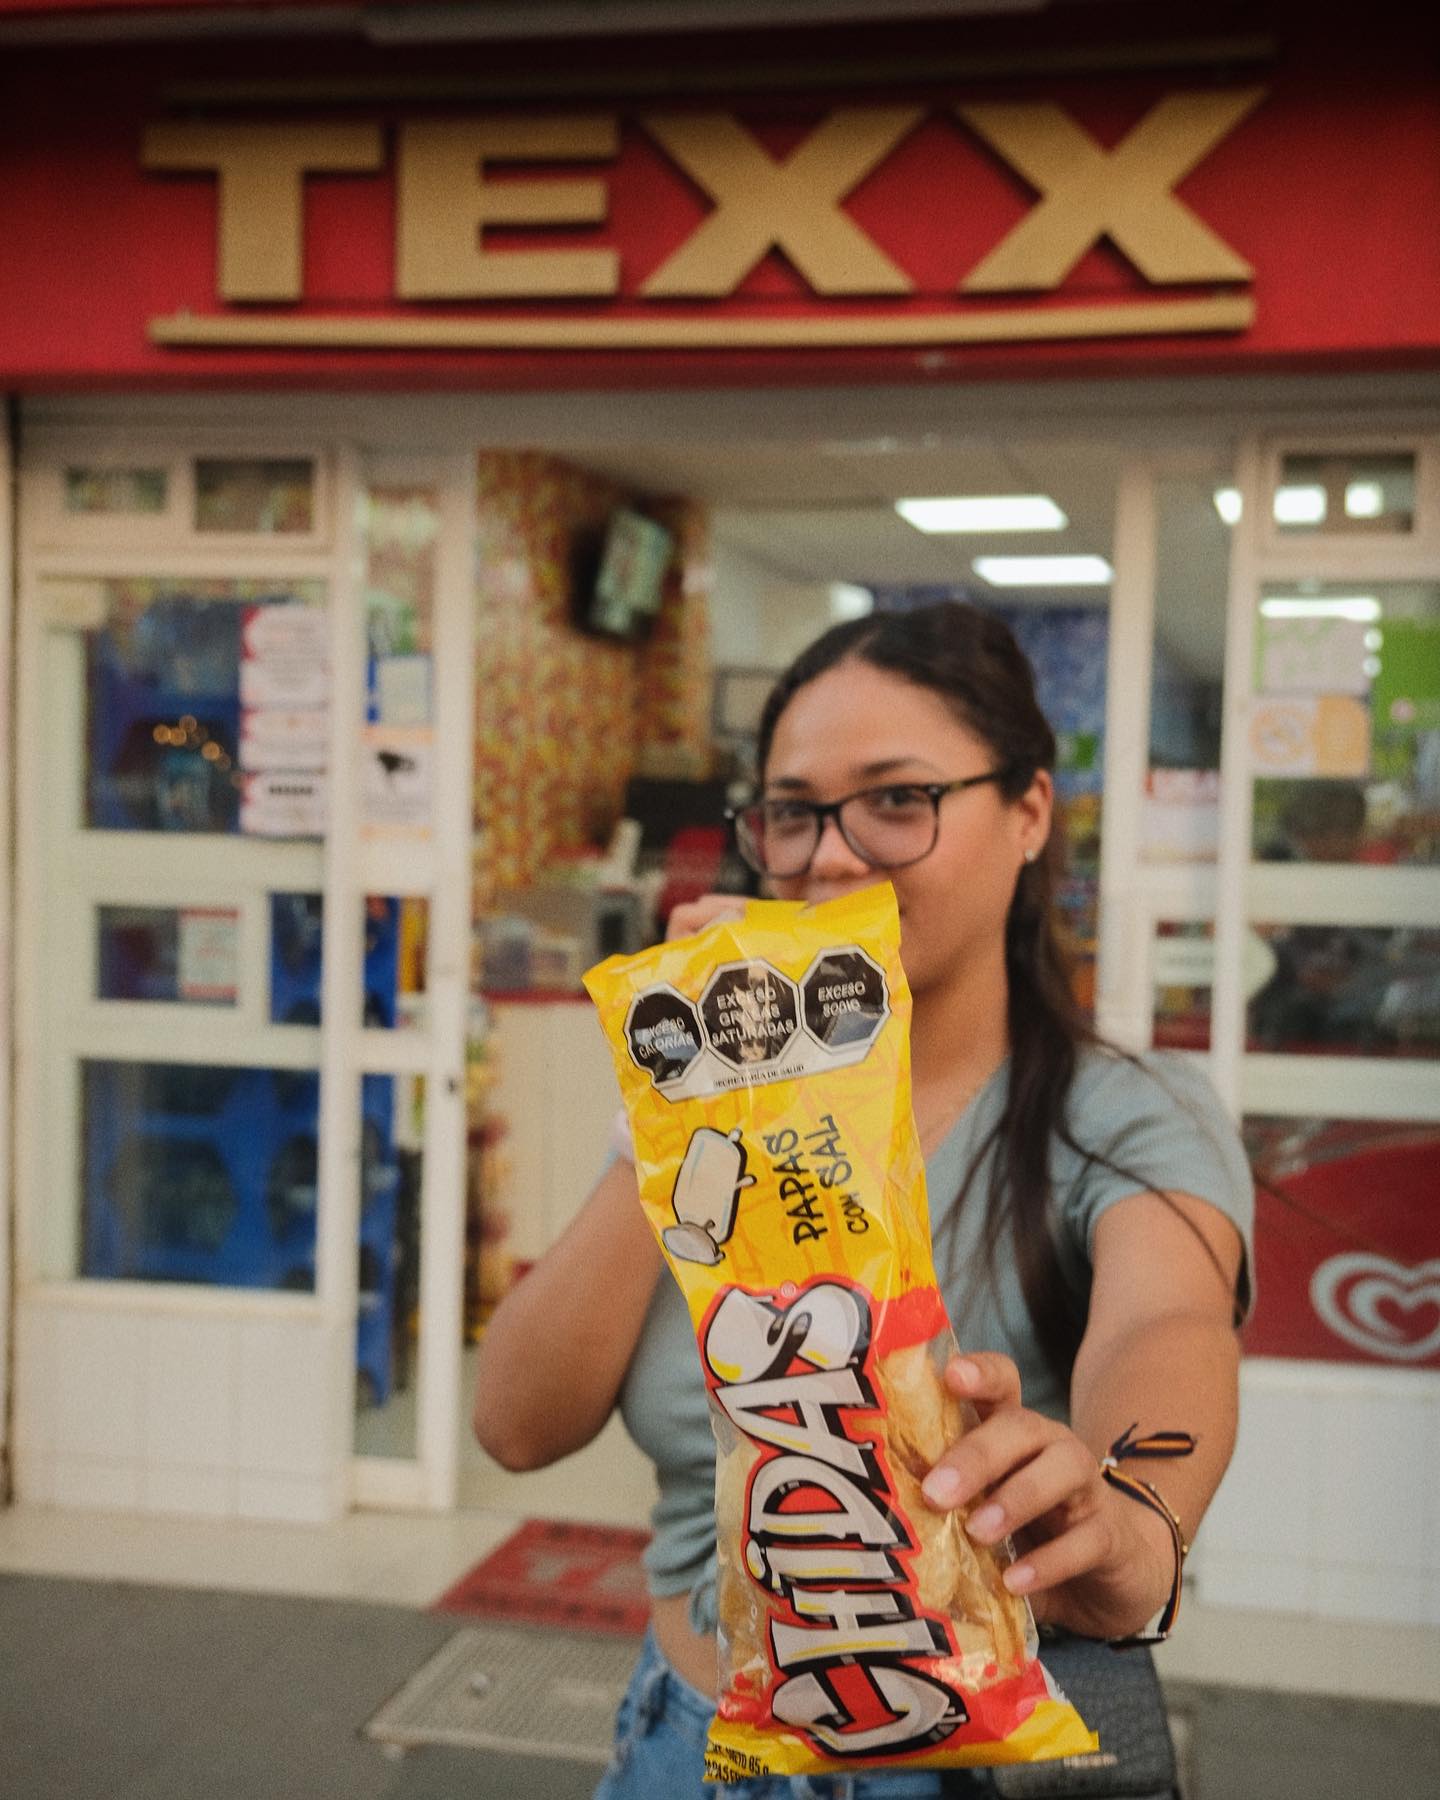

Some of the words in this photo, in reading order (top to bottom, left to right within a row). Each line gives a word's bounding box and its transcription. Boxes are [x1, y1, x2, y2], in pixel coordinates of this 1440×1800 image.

[141, 88, 1268, 304] TEXX
[818, 980, 867, 1002] EXCESO
[719, 1003, 781, 1027] GRAS
[822, 998, 862, 1018] SODIO
[638, 1032, 695, 1060] CALORIAS
[711, 1019, 795, 1047] SATURADAS
[803, 1113, 853, 1190] SAL
[762, 1128, 829, 1246] PAPAS
[839, 1190, 869, 1235] CON
[749, 1754, 761, 1777] 85
